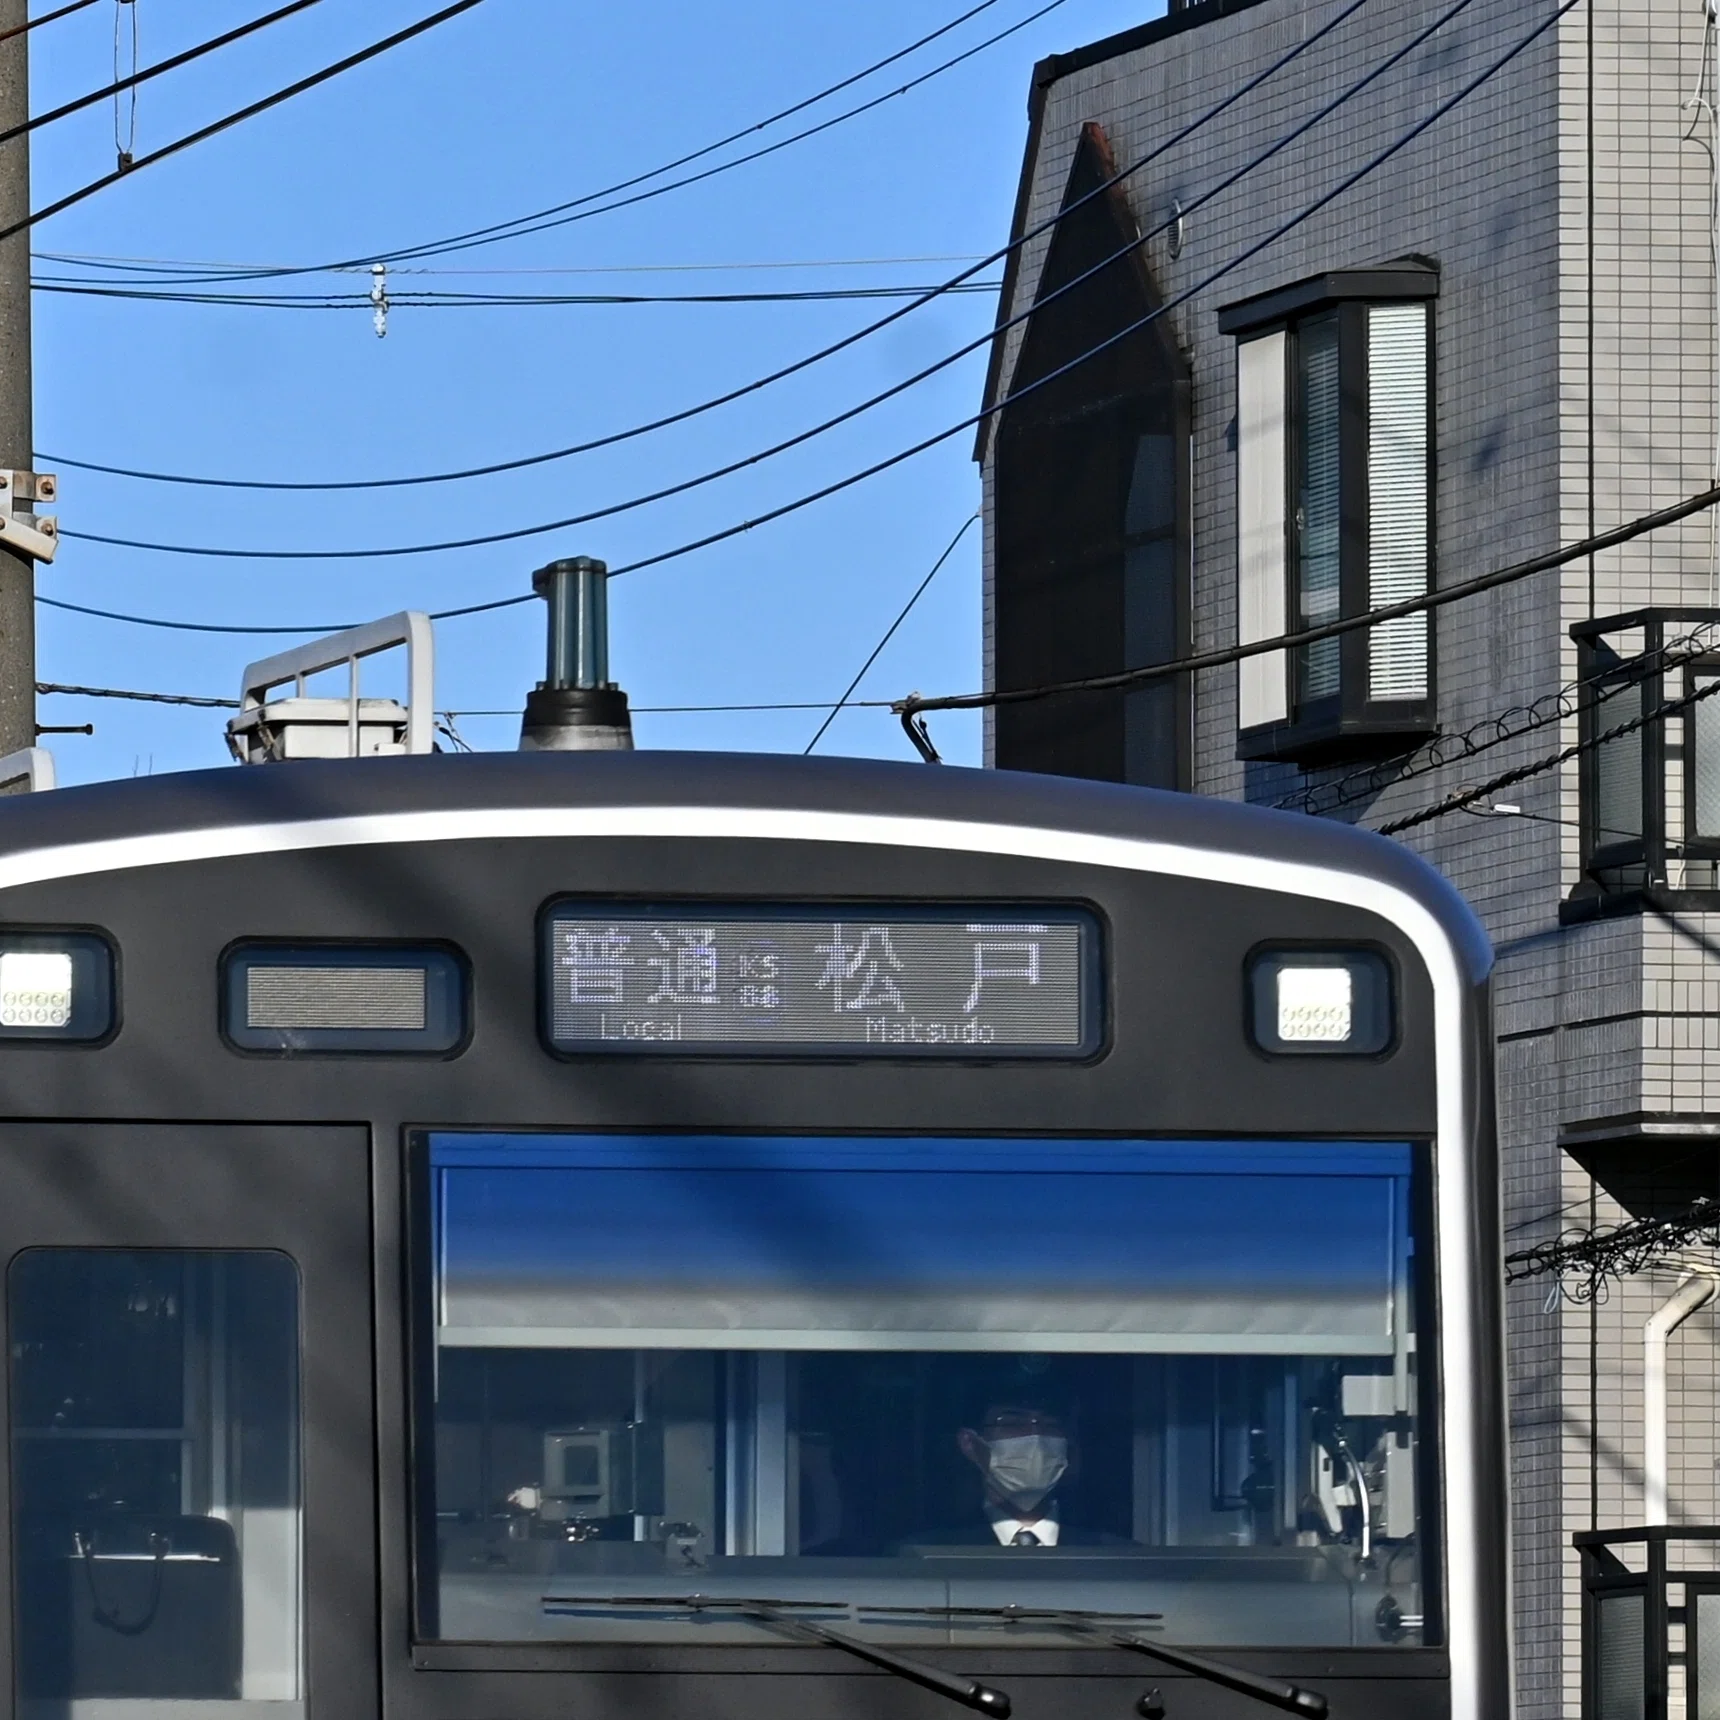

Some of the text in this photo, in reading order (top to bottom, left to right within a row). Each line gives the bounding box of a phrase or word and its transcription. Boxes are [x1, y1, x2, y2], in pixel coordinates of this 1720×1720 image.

[561, 923, 1049, 1013] 普通 松戸
[739, 955, 780, 978] KS
[600, 1012, 996, 1044] Local Matsudo
